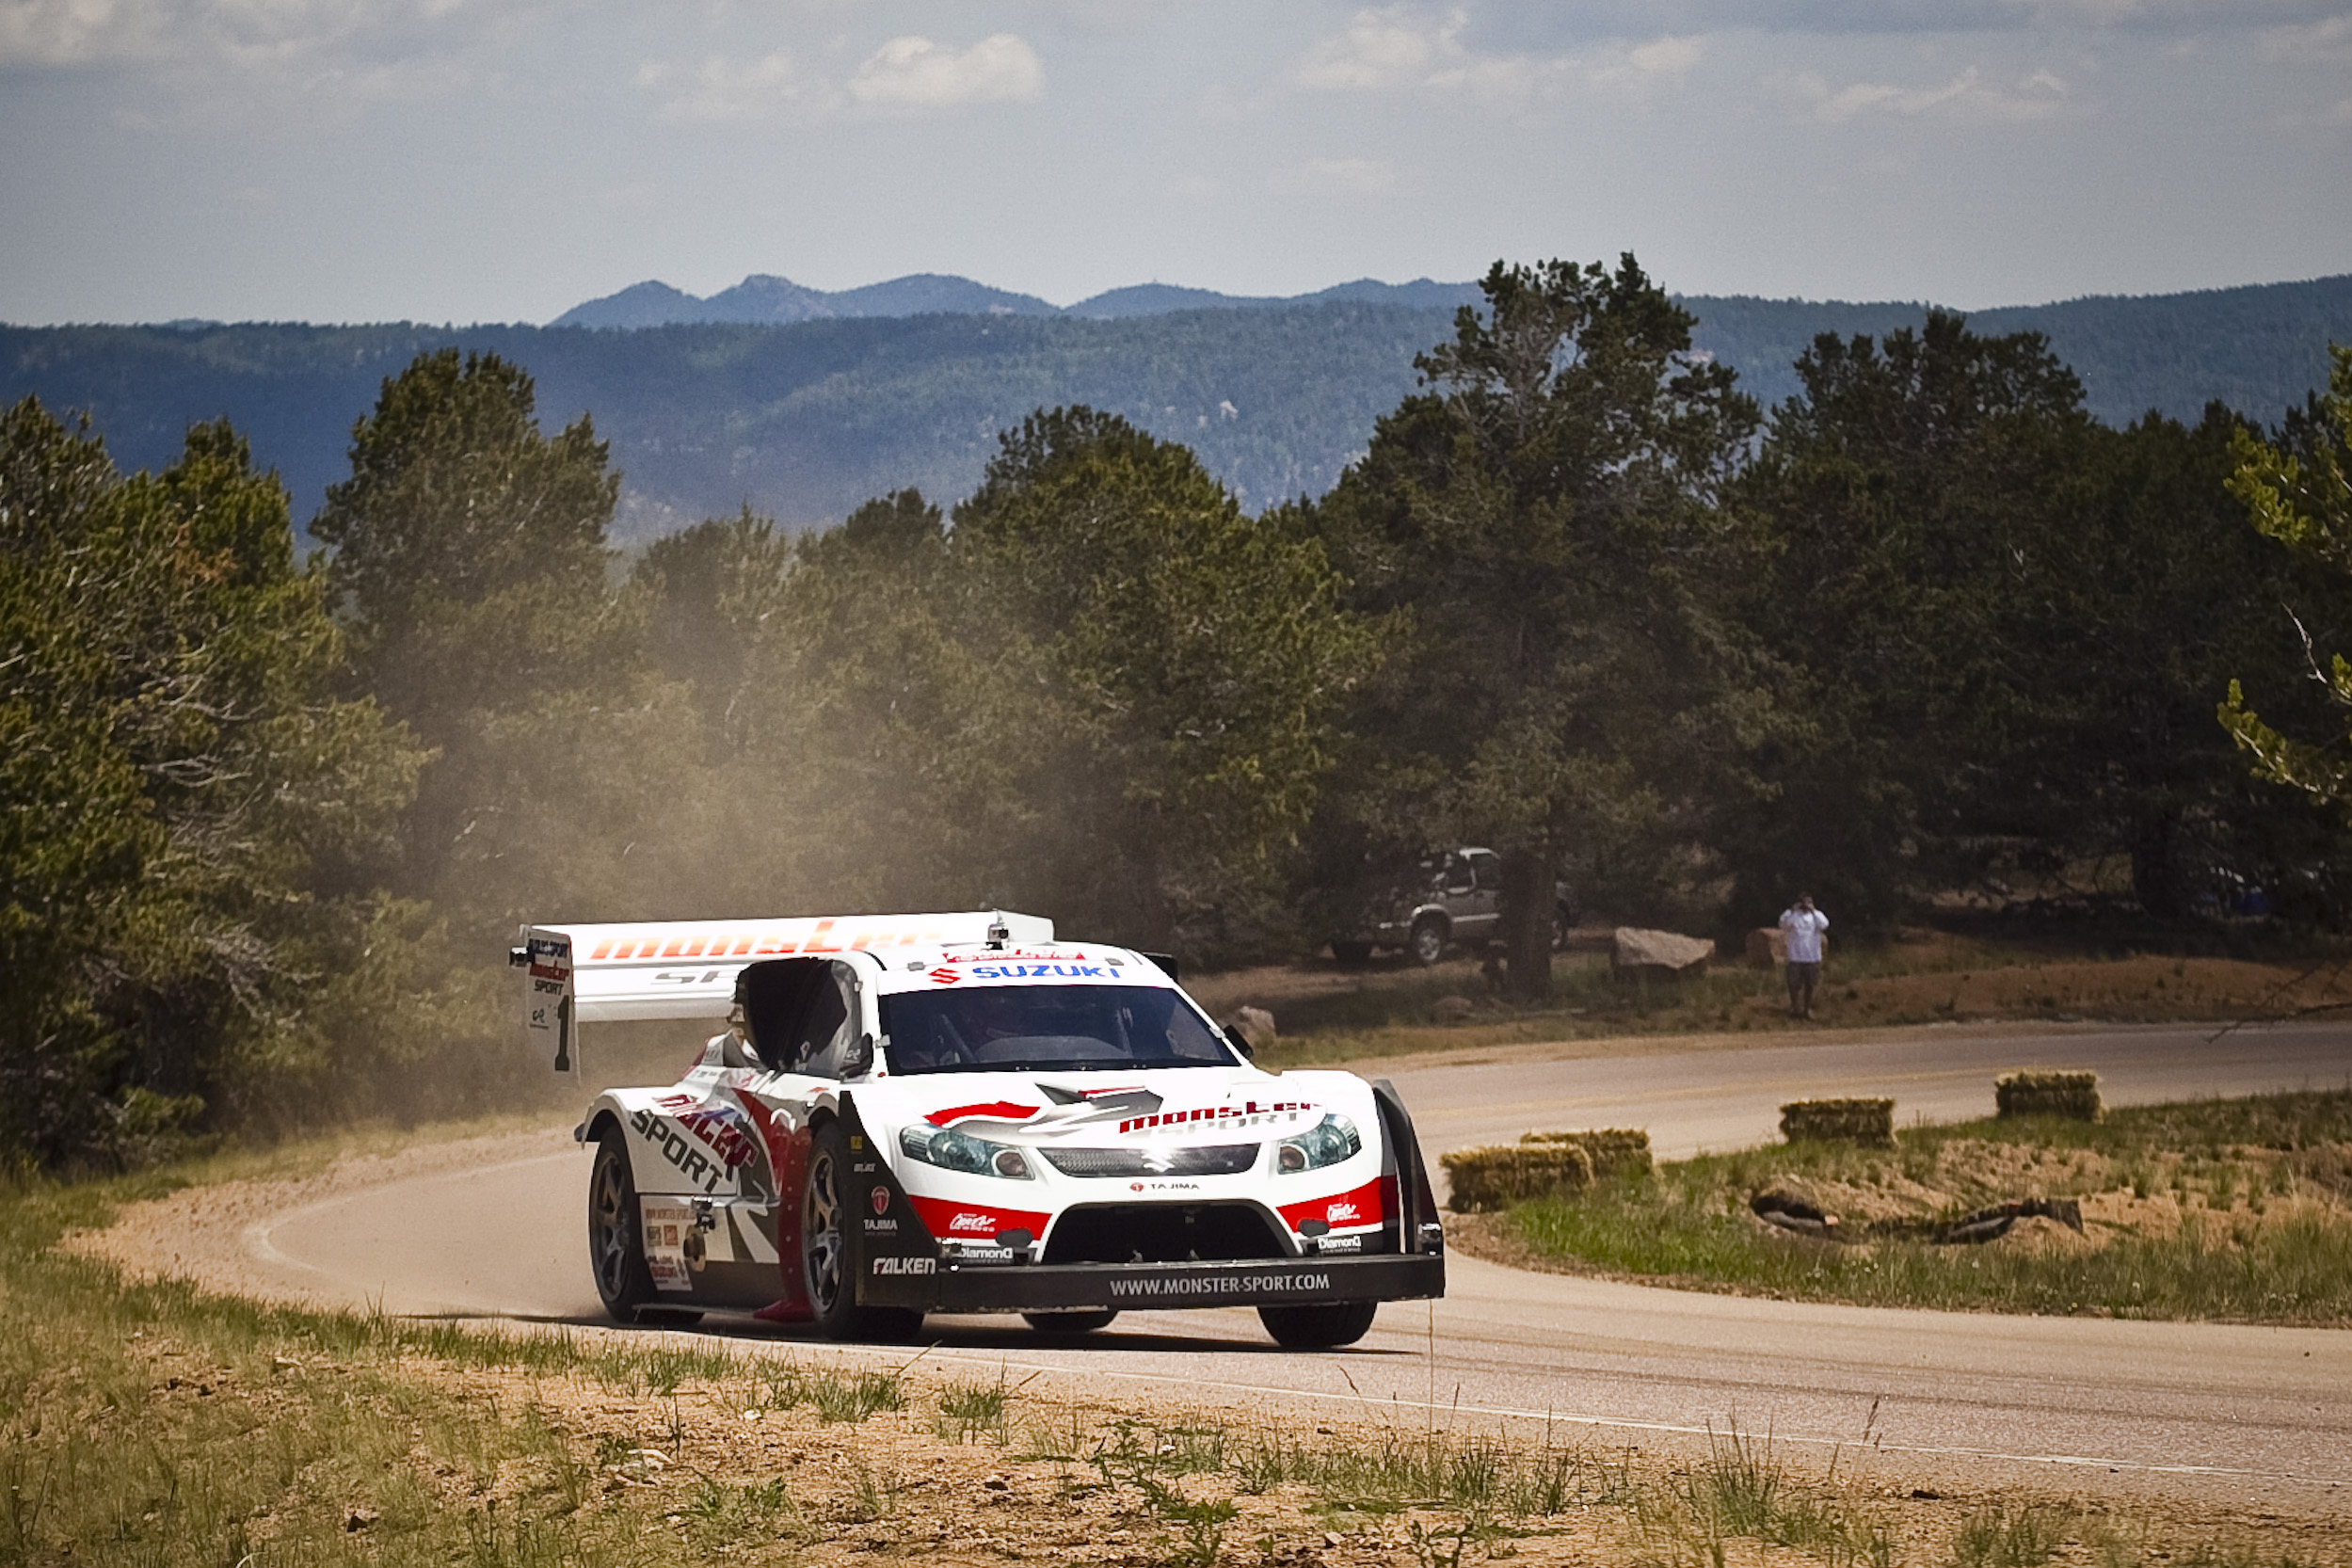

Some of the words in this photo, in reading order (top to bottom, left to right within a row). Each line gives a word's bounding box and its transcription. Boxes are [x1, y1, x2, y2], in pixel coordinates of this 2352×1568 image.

[589, 920, 943, 960] monst
[972, 965, 1121, 980] SUZUKI
[1119, 1100, 1323, 1134] monster
[631, 1108, 723, 1193] SPORT
[872, 1256, 936, 1275] FALKEN
[1110, 1273, 1331, 1297] WWW.MONSTER-SPORT.COM
